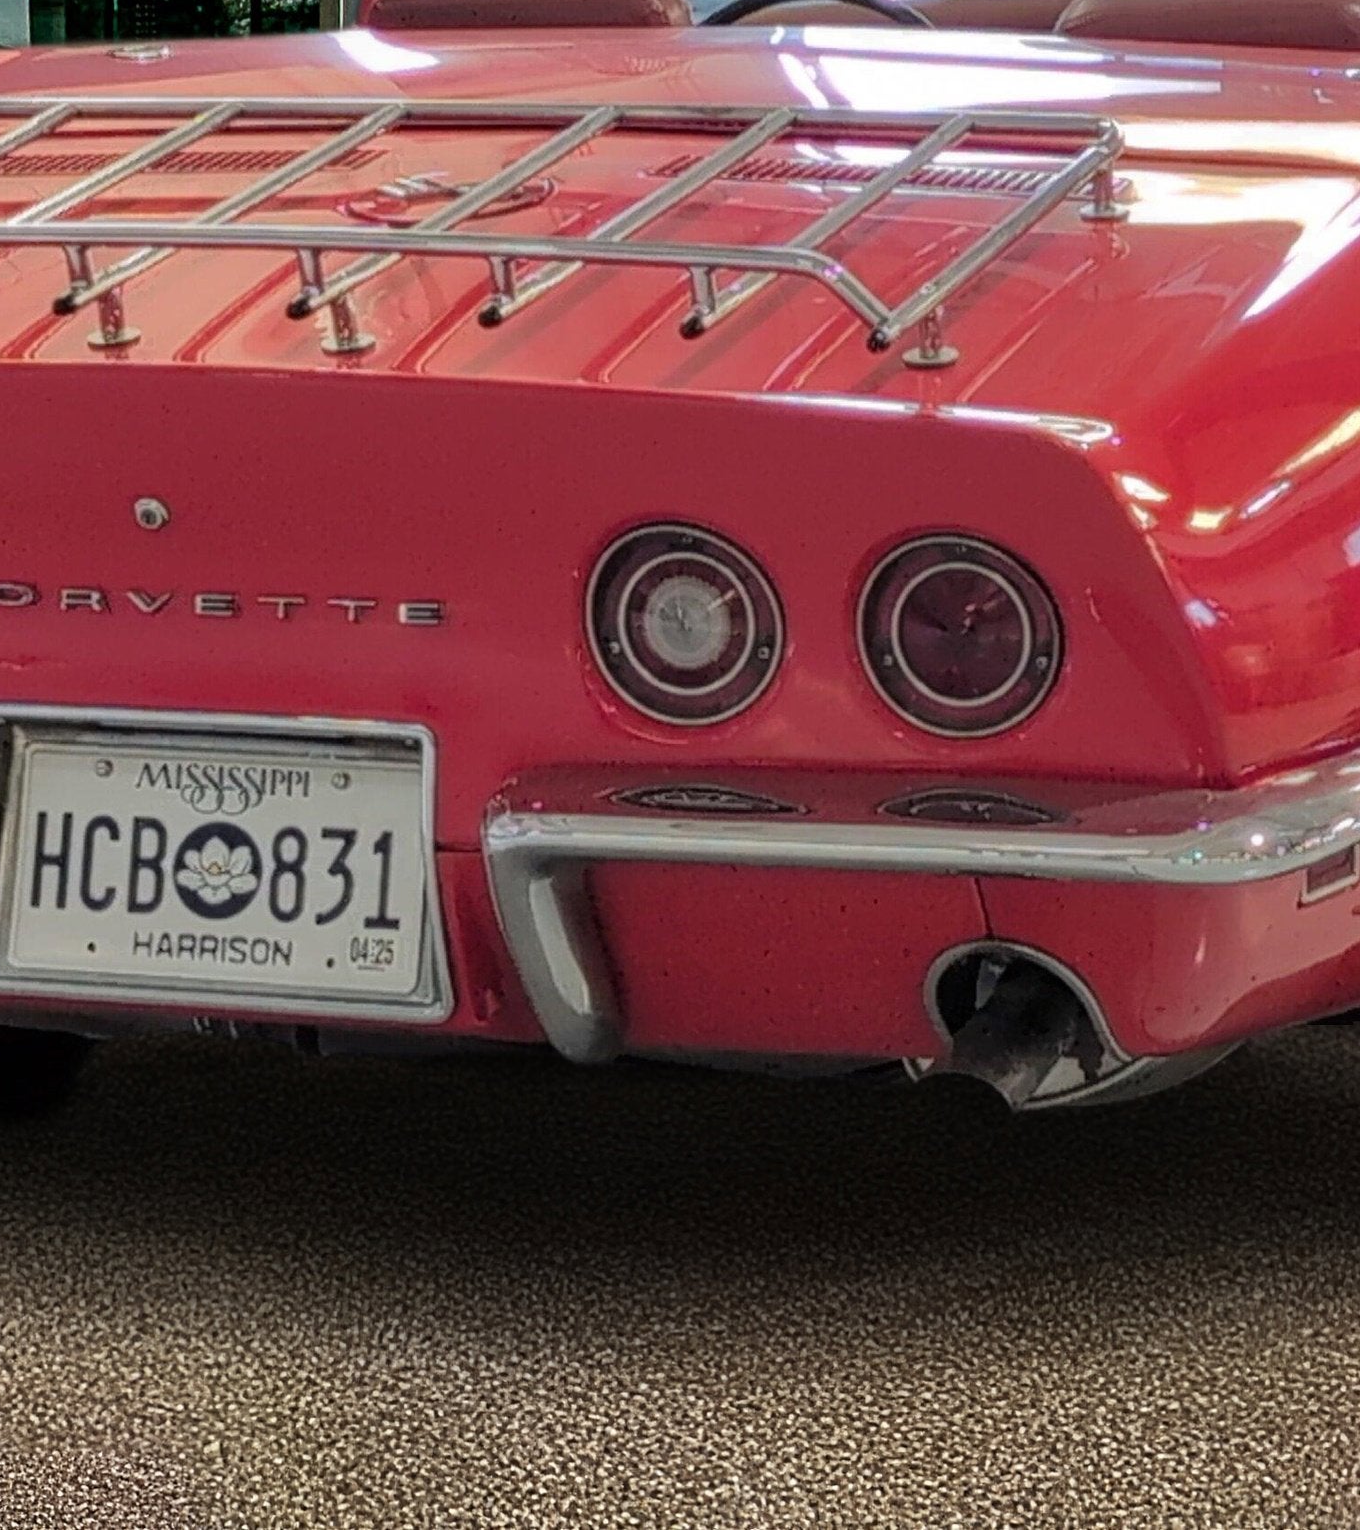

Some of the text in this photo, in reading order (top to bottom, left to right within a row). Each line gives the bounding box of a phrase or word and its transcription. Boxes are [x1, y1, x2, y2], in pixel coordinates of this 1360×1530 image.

[135, 762, 310, 816] MISSISSIPPI
[30, 811, 401, 931] HCB 831
[131, 930, 294, 966] HARRISON
